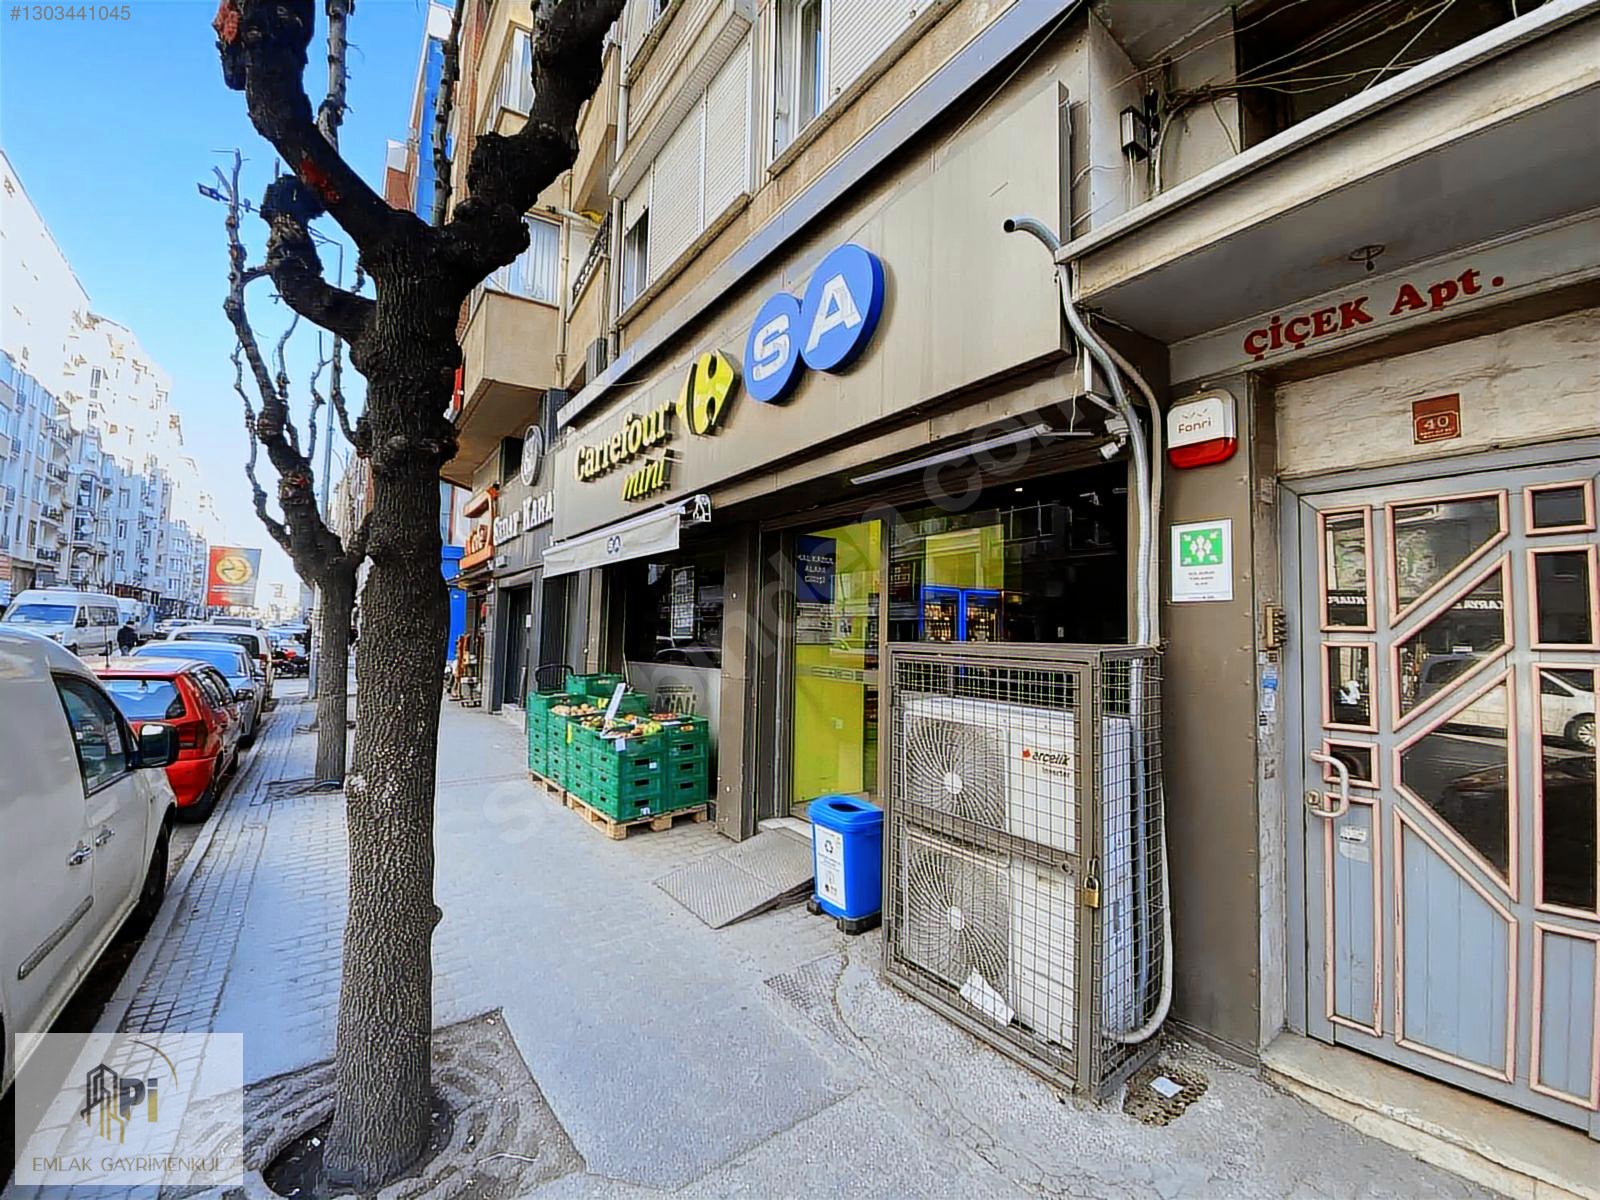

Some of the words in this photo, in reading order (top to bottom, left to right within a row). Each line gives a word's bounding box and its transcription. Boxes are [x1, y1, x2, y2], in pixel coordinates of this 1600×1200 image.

[1243, 297, 1374, 361] ÇİÇEK
[574, 401, 672, 482] Carrefour
[622, 449, 668, 500] mini
[522, 489, 555, 532] KARA
